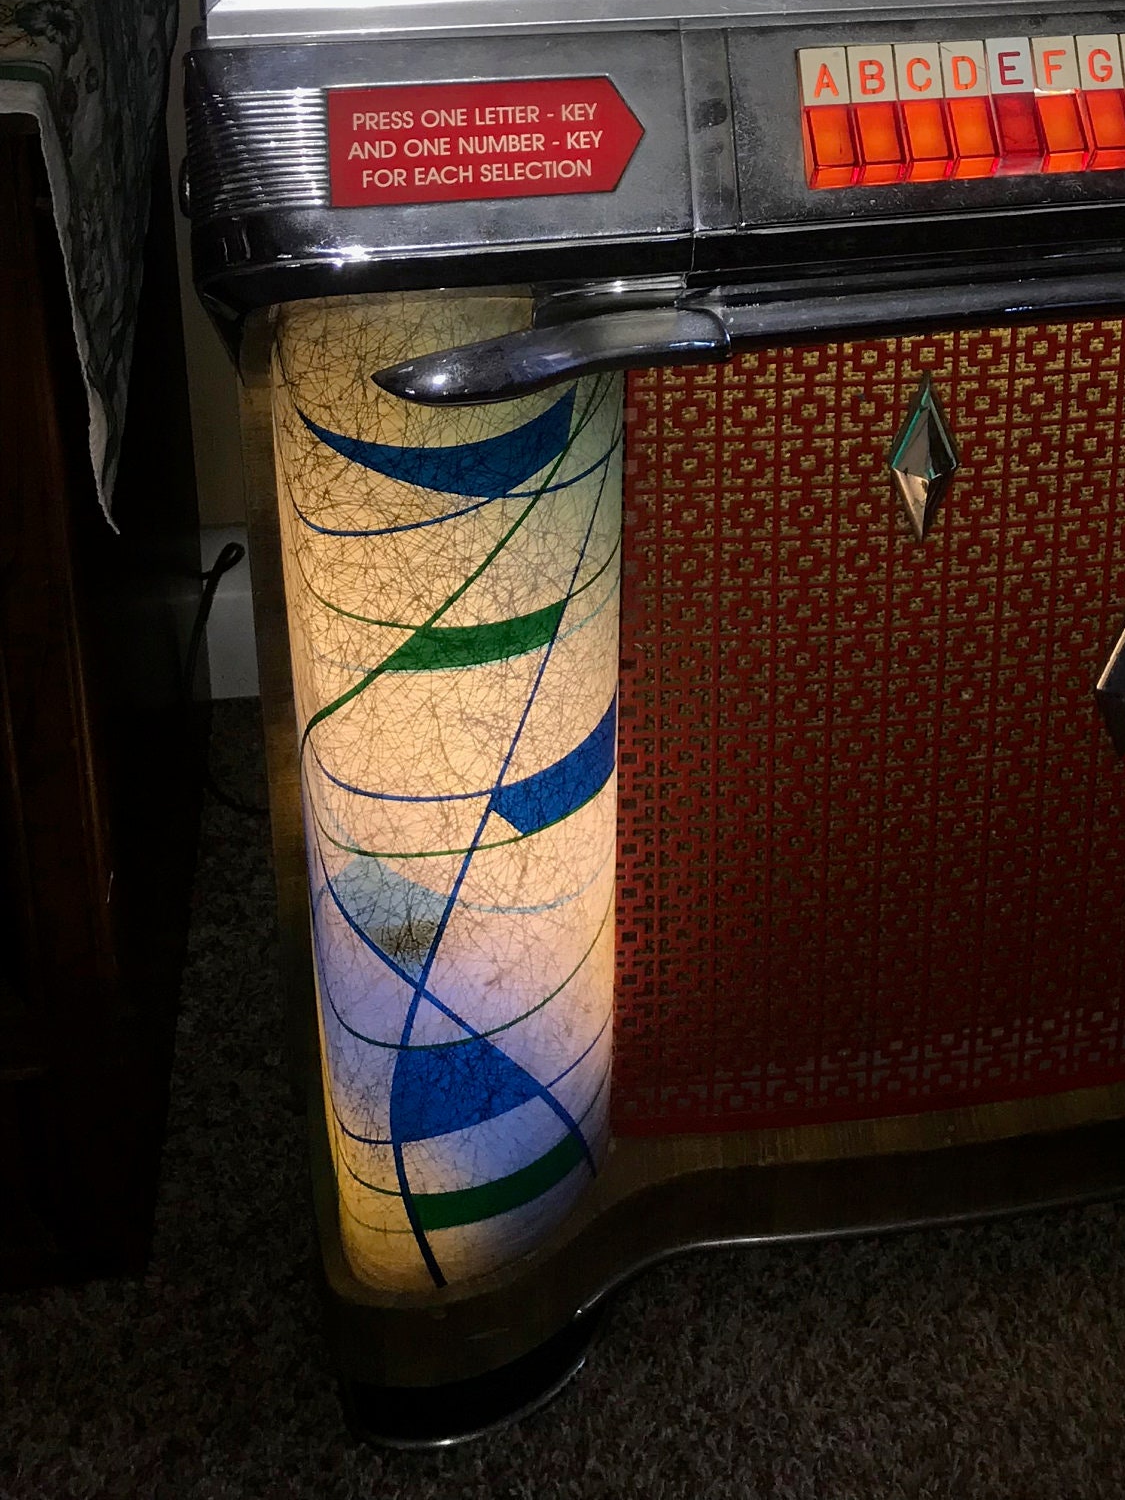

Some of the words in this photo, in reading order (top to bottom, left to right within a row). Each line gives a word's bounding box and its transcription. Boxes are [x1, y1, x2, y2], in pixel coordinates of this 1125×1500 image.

[814, 63, 839, 98] A
[858, 60, 886, 94] B
[906, 57, 933, 92] C
[952, 55, 978, 90] D
[999, 51, 1024, 86] E
[1043, 49, 1067, 85] F
[1088, 48, 1112, 83] G
[352, 111, 414, 131] PRESS
[421, 109, 467, 128] ONE
[475, 106, 539, 125] LETTER
[561, 103, 597, 121] KEY
[348, 140, 396, 160] AND
[404, 137, 451, 158] ONE
[459, 134, 545, 155] NUMBER
[567, 130, 603, 149] KEY
[362, 169, 407, 188] FOR
[414, 165, 473, 185] EACH
[480, 159, 592, 183] SELECTION
